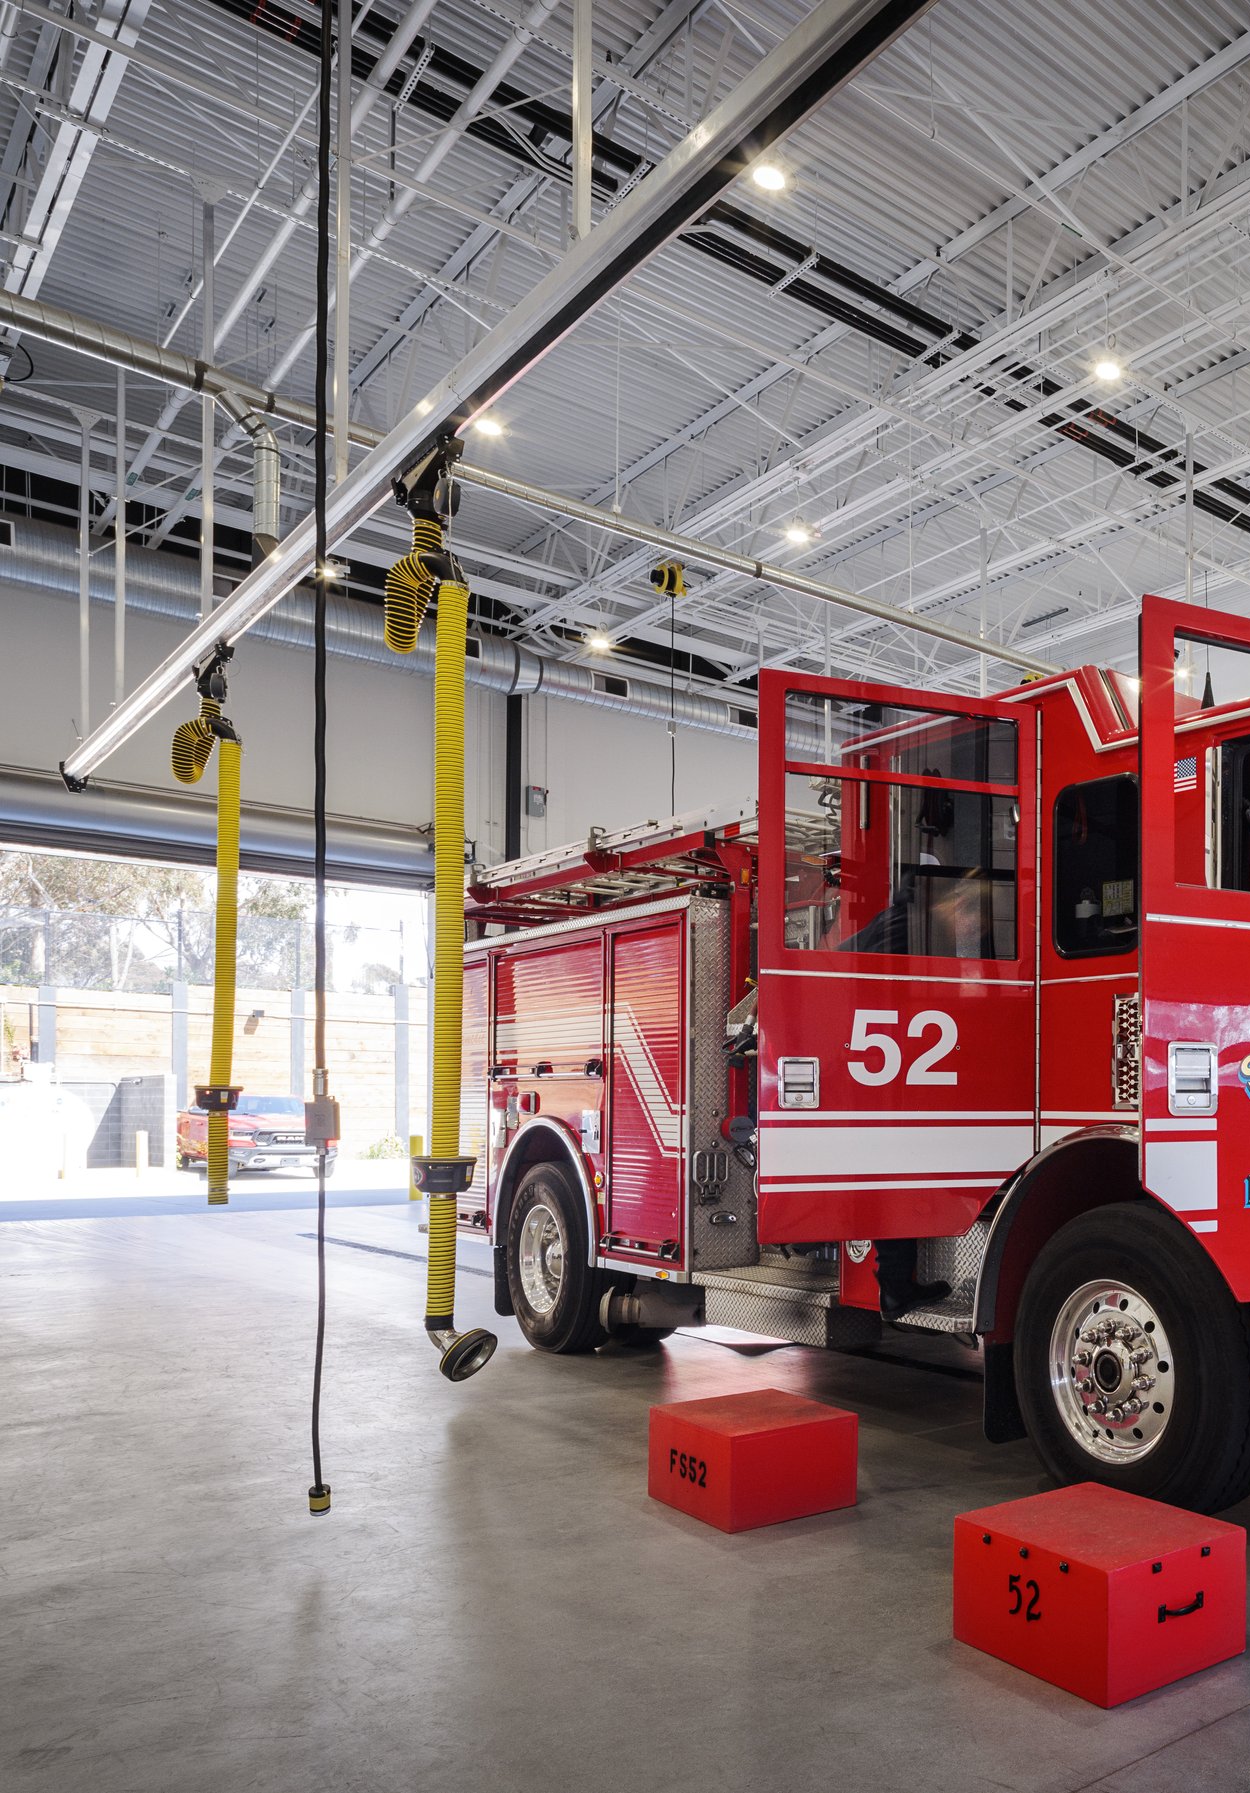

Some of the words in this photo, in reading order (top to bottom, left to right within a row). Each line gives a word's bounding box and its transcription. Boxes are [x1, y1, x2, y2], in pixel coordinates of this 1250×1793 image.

[847, 1009, 958, 1087] 52
[670, 1448, 707, 1488] FS52
[1009, 1574, 1042, 1622] 52
